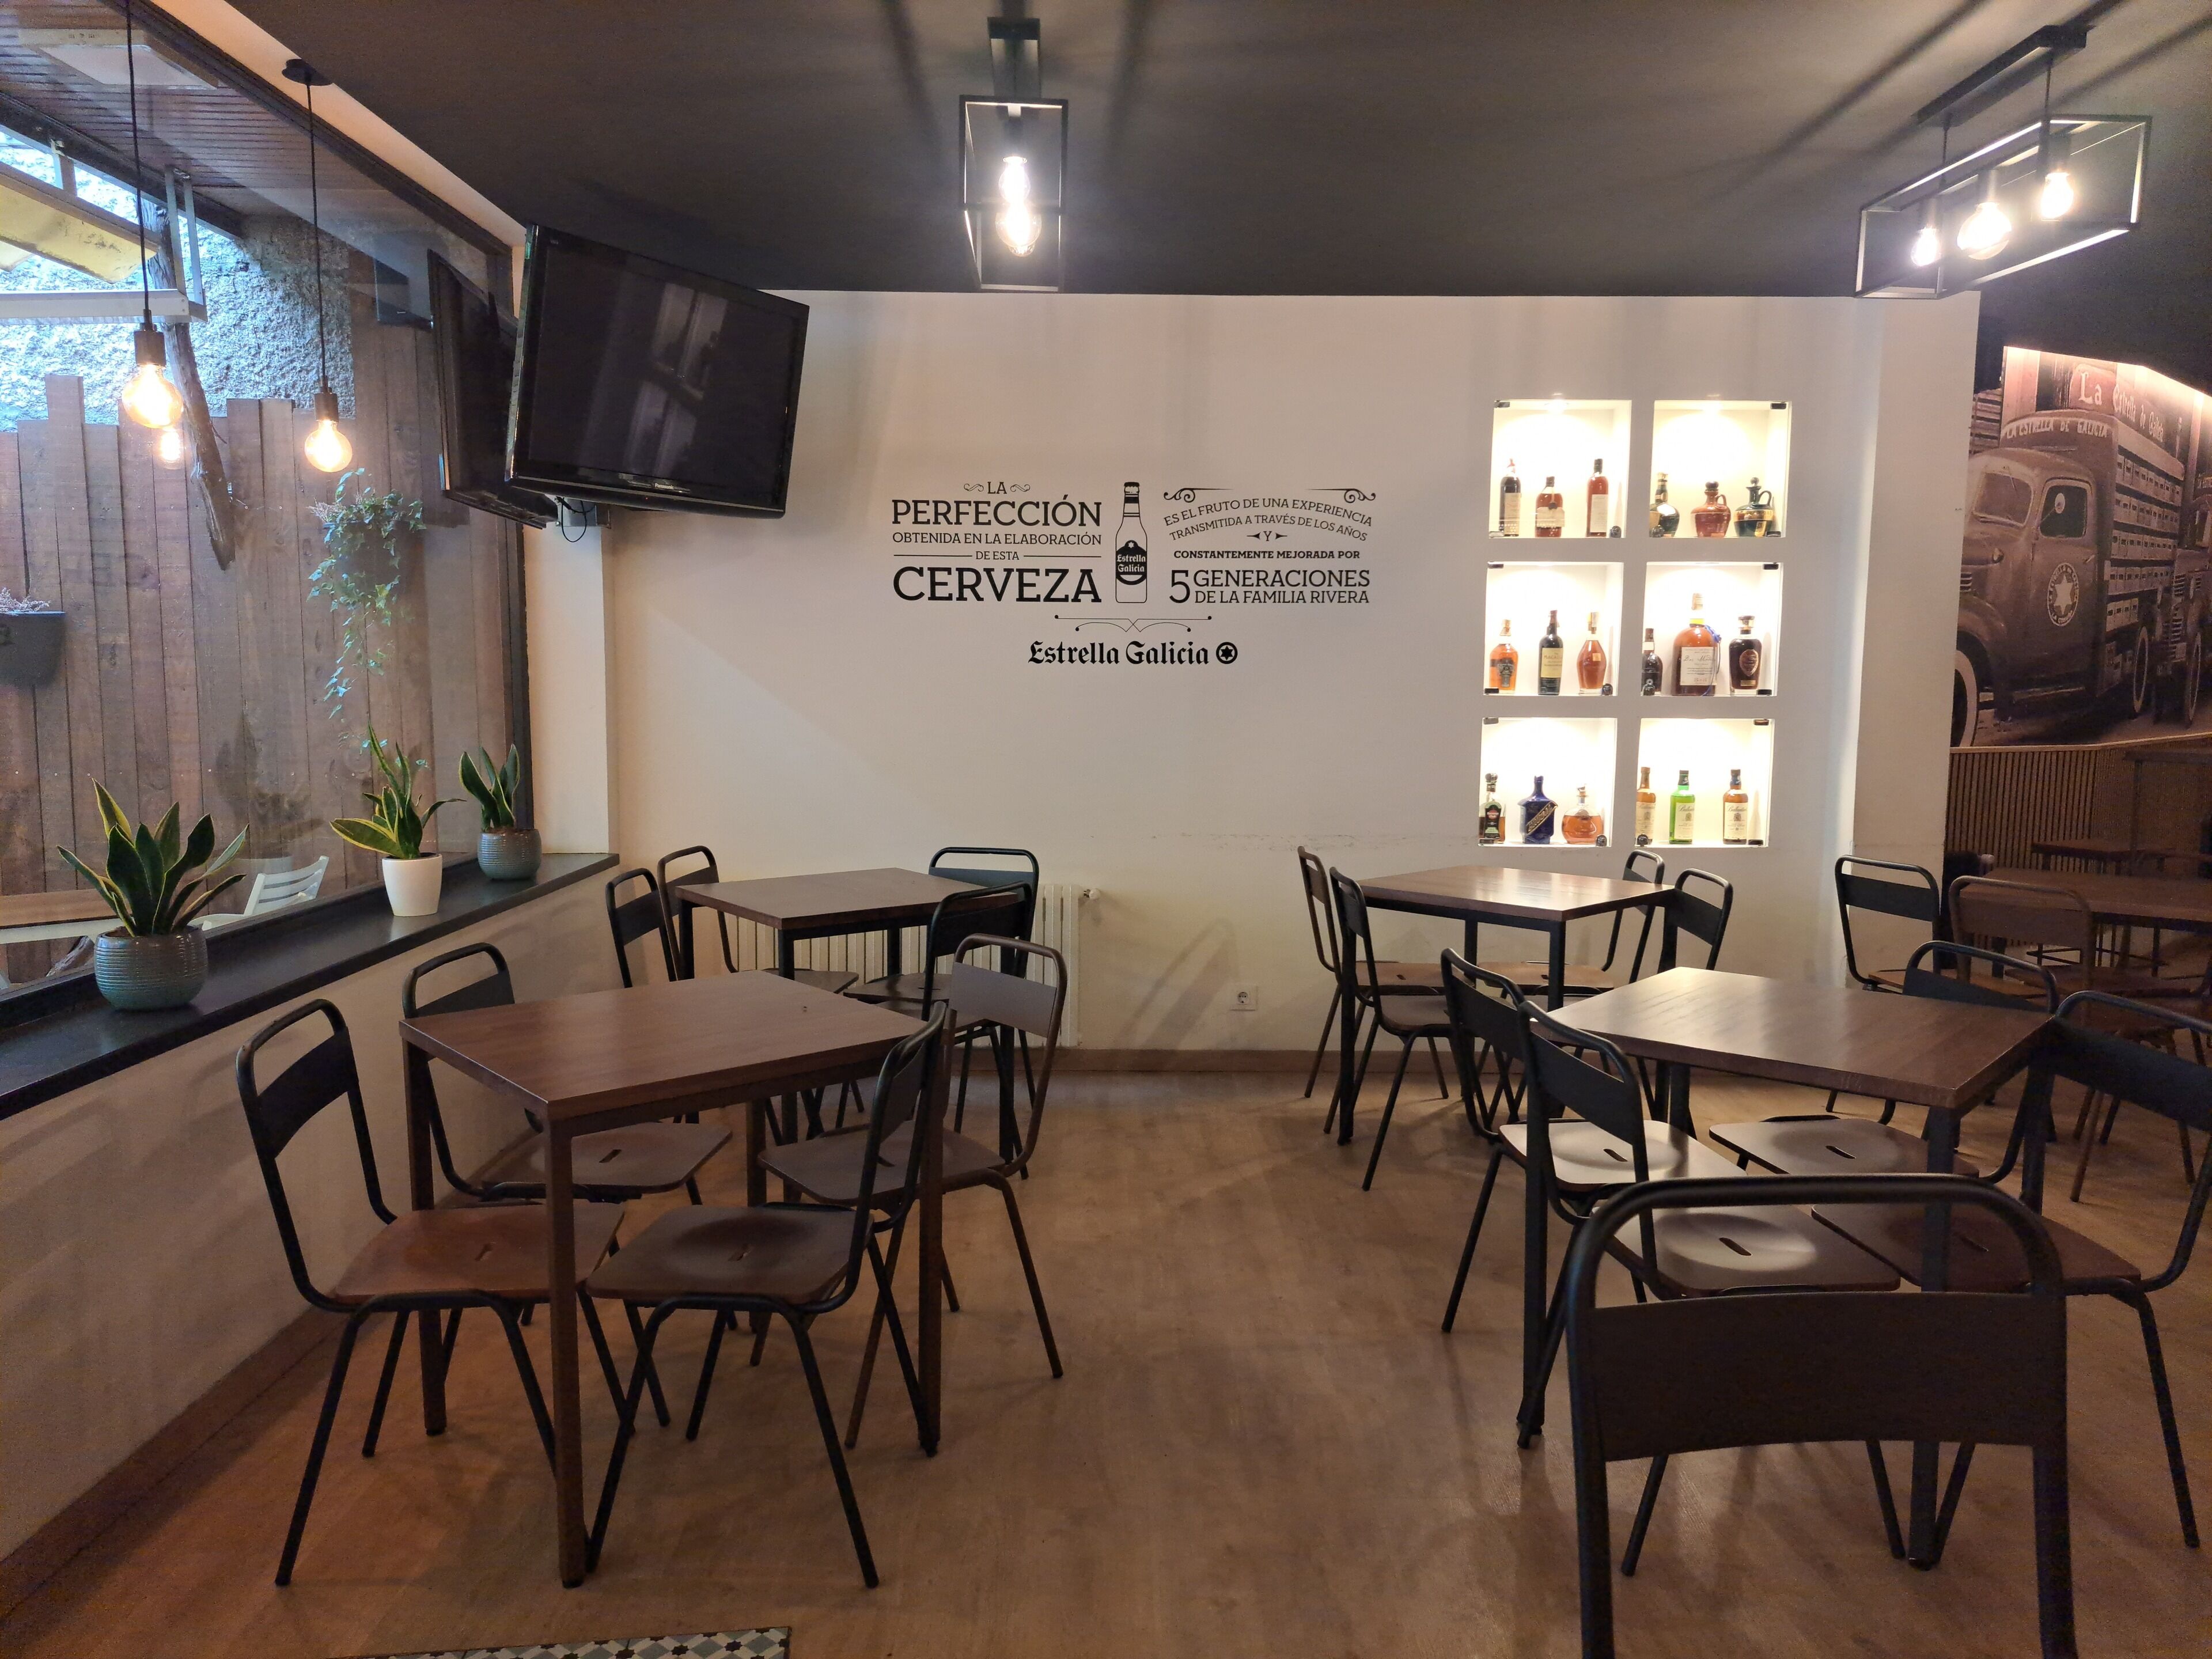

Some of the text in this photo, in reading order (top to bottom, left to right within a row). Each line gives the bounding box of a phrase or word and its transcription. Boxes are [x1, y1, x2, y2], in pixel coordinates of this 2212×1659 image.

[2078, 372, 2102, 406] La
[2006, 419, 2107, 438] LA ESTRELLA DE GALICIA
[987, 482, 1007, 494] LA
[892, 494, 1101, 527] PERFECCIÓN
[1164, 498, 1372, 527] ES EL FRUTO DE UNA EXPERIENCIA
[1169, 513, 1368, 541] TRANSMITIDA A TRAVÉS DE LOS AÑOS
[893, 531, 1101, 545] OBTENIDA EN LA ELABORACIÓN
[1263, 531, 1272, 541] Y
[976, 551, 1020, 560] DE ESTA
[1117, 554, 1146, 562] Estrella
[1174, 551, 1359, 559] CONSTANTEMENTE MEJORADA POR
[1118, 564, 1145, 572] Galicia
[893, 566, 1101, 603] CERVEZA
[1169, 570, 1370, 603] 5 GENERACIONES
[1195, 590, 1369, 604] DE LA FAMILIA RIVERA
[1028, 641, 1209, 665] Estrella Galicia
